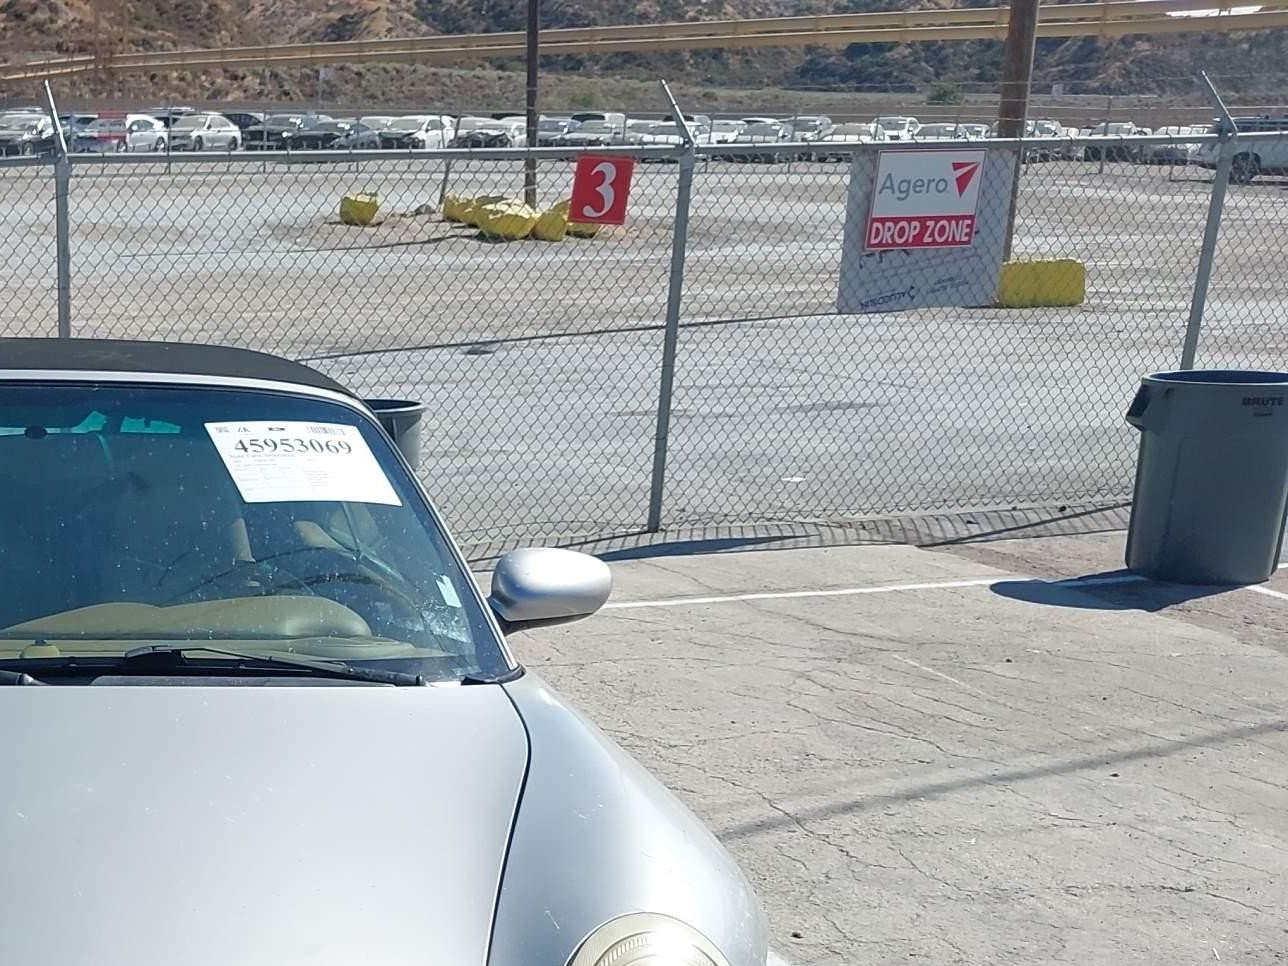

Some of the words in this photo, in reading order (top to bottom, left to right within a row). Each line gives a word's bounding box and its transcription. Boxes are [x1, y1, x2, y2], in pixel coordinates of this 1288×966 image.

[583, 162, 616, 217] 3
[878, 173, 948, 201] Agero
[870, 221, 920, 244] DROP
[923, 220, 972, 242] ZONE
[234, 437, 352, 455] 45953069
